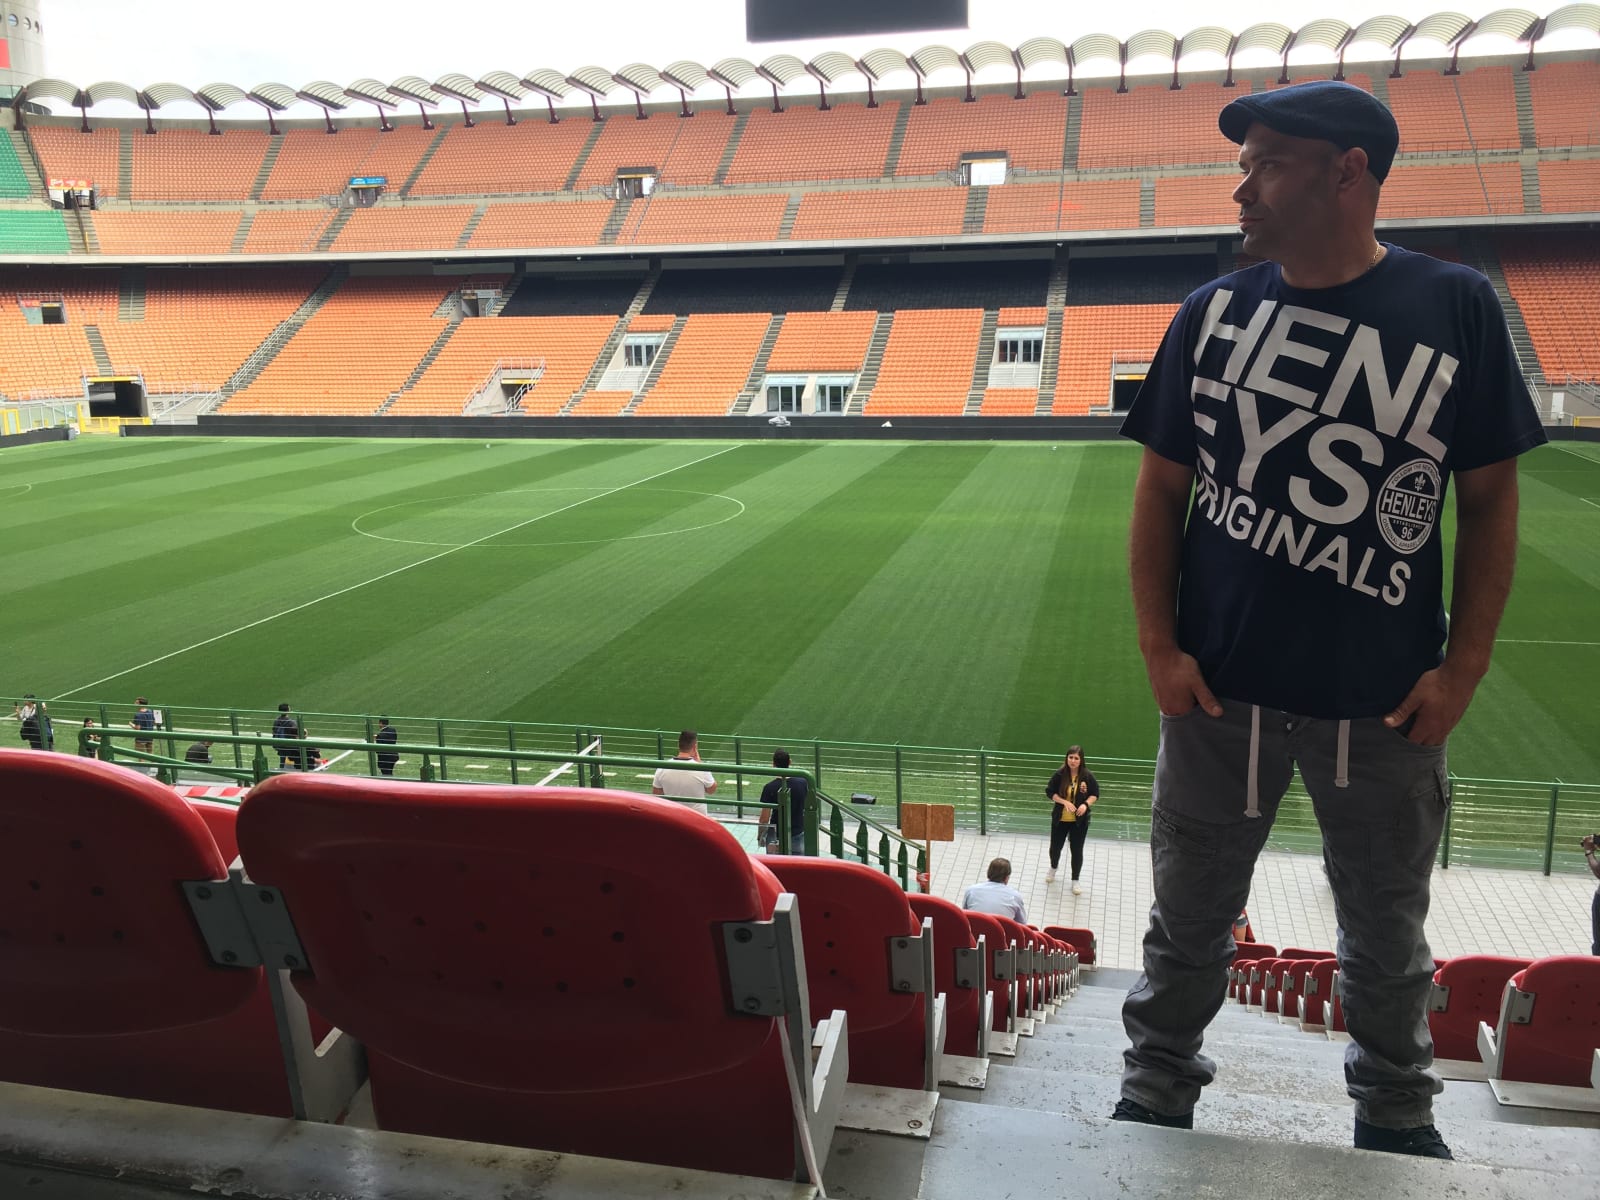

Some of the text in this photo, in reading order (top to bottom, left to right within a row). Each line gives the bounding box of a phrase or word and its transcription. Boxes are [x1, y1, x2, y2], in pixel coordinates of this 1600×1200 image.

[1194, 288, 1459, 463] HENL
[1191, 375, 1385, 525] EYS
[1381, 489, 1436, 522] HENLEYS
[1401, 526, 1414, 540] 96
